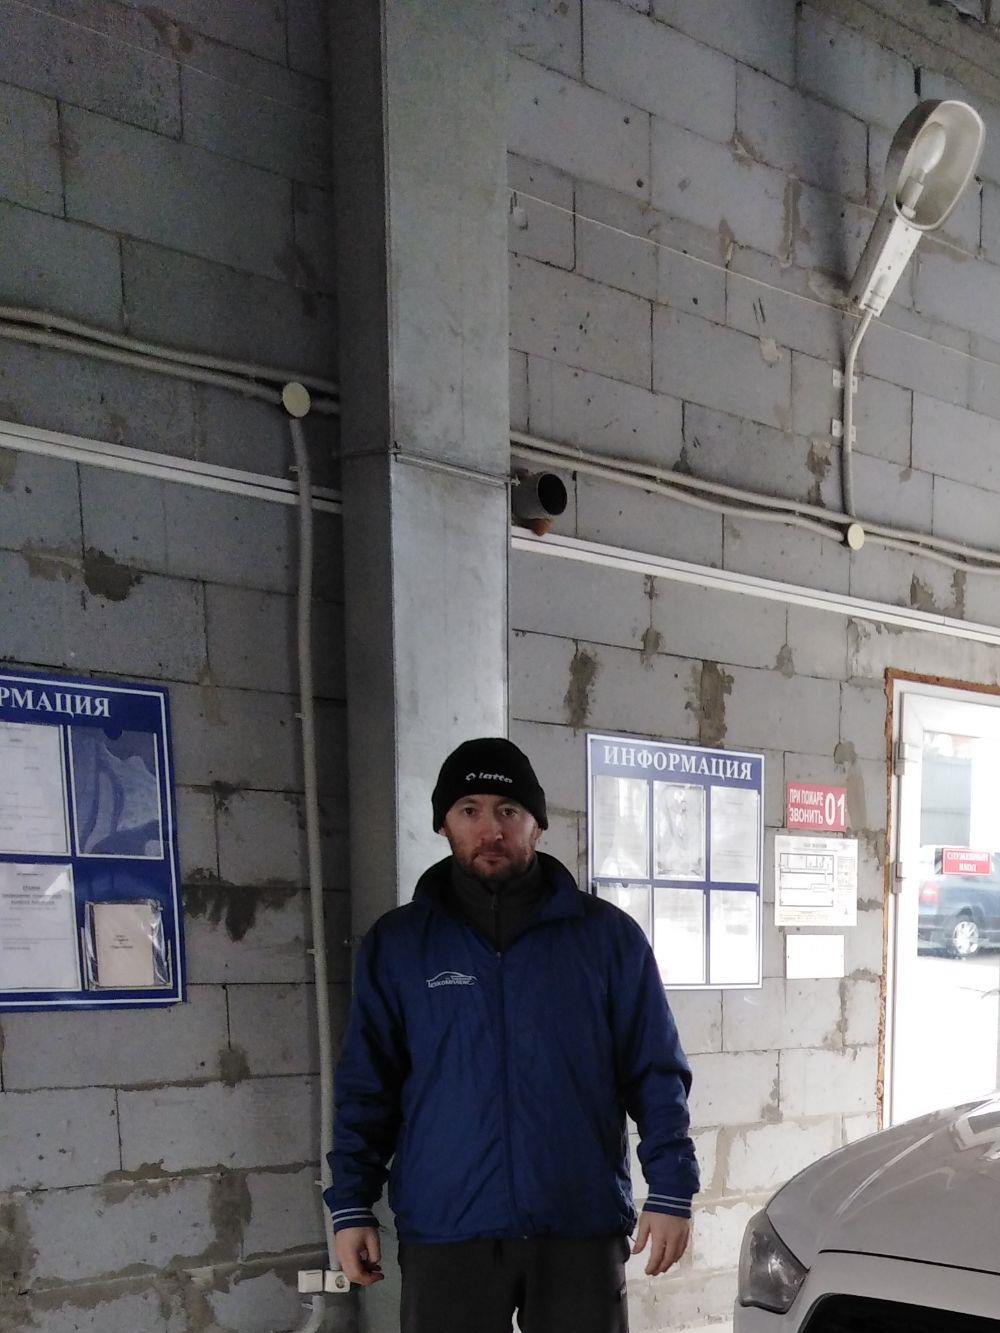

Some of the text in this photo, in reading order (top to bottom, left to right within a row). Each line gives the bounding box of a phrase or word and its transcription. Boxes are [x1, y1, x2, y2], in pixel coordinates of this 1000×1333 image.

[0, 686, 111, 718] РМАЦИЯ
[604, 745, 753, 781] ИНФОРМАЦИЯ
[790, 789, 824, 806] ПРИ ПОЖАРЕ
[825, 792, 845, 826] 01
[789, 808, 823, 825] ЗВОНИТЬ
